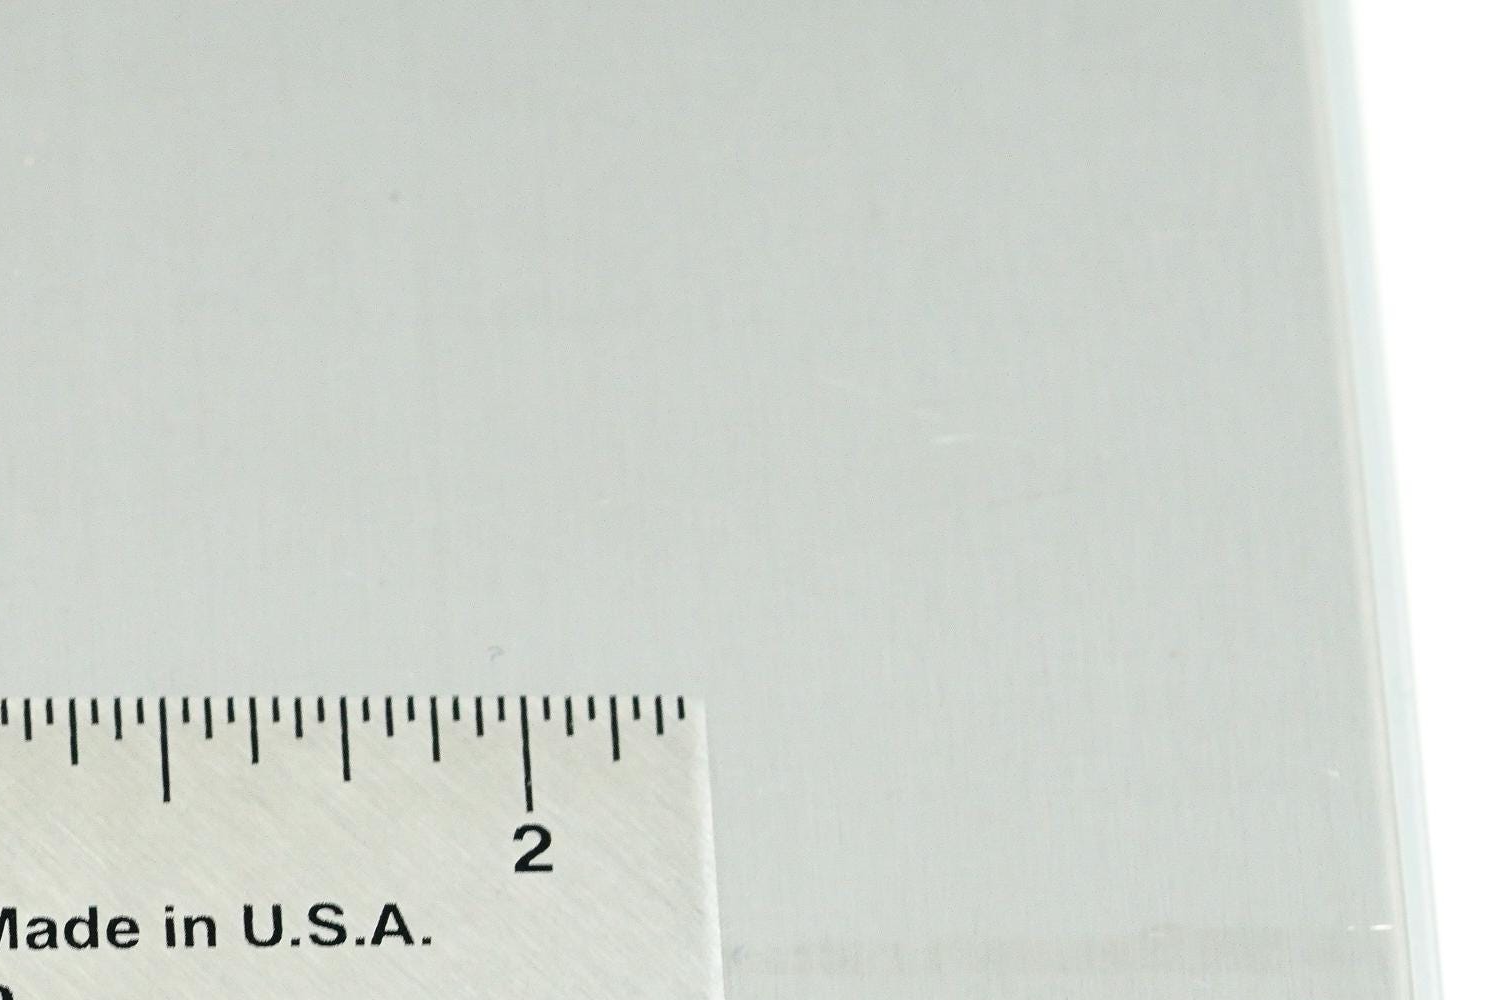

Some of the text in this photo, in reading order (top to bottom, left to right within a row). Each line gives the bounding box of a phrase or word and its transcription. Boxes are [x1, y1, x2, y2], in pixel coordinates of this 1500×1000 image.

[513, 824, 554, 873] 2
[164, 903, 217, 948] in
[243, 902, 433, 947] U.S.A.
